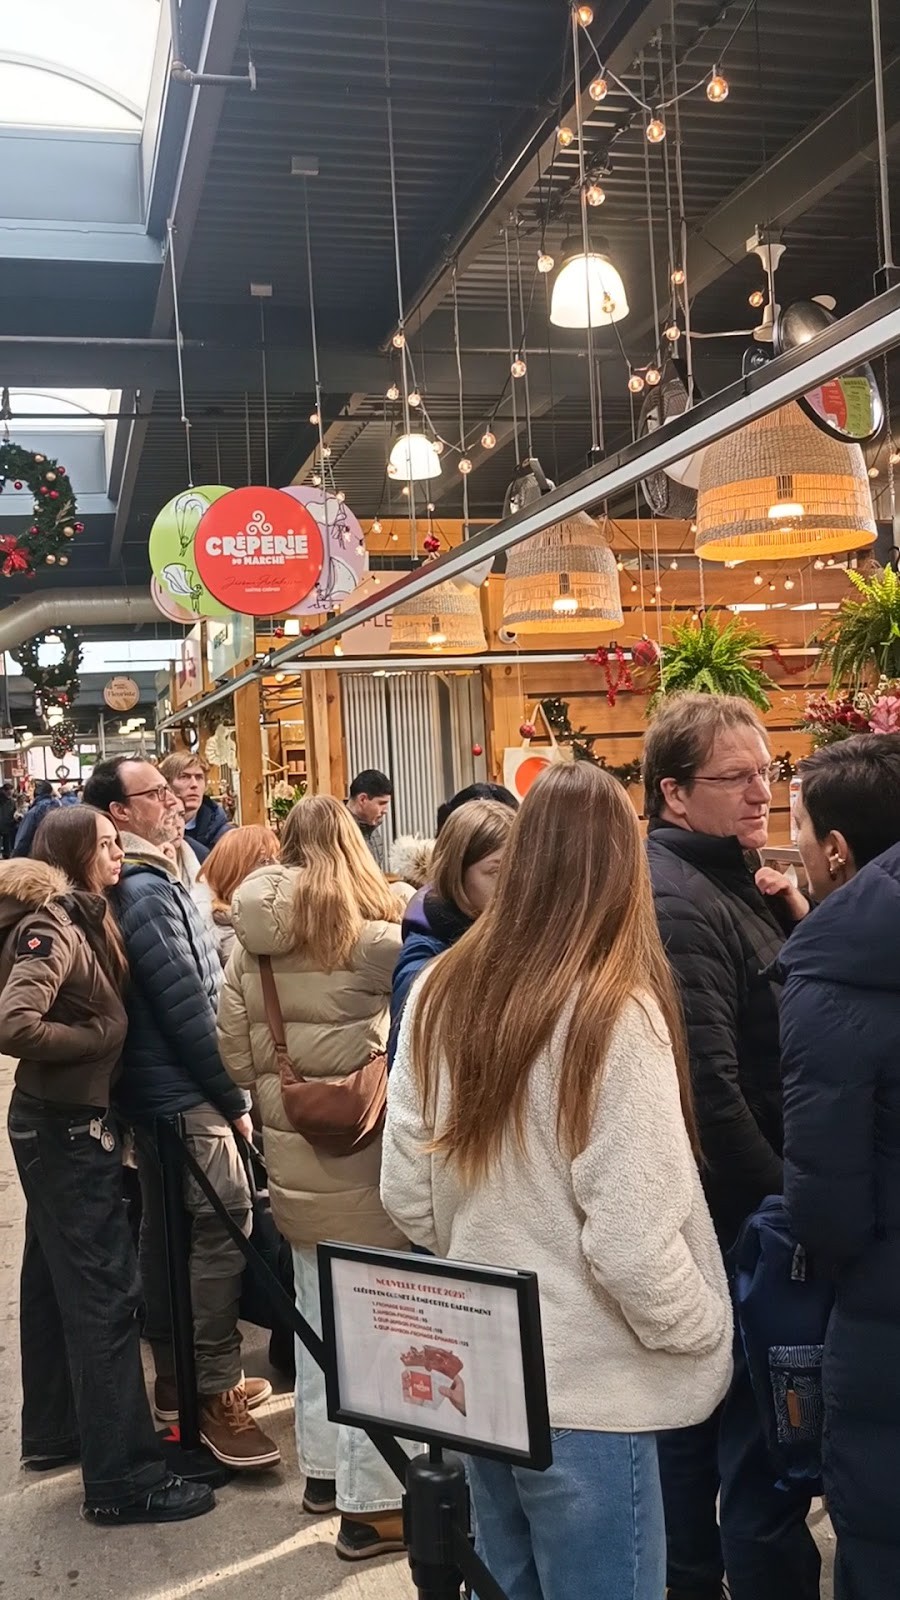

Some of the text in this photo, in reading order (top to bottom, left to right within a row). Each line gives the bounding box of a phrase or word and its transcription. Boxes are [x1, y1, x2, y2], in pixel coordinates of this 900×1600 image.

[205, 530, 308, 558] CRÊPERIE
[244, 554, 286, 565] MARCHÉ
[375, 1278, 416, 1290] NOUVELLE
[417, 1283, 443, 1296] OFFRE
[416, 1296, 450, 1309] EMPORTER
[450, 1303, 492, 1317] RAPIDEMENT
